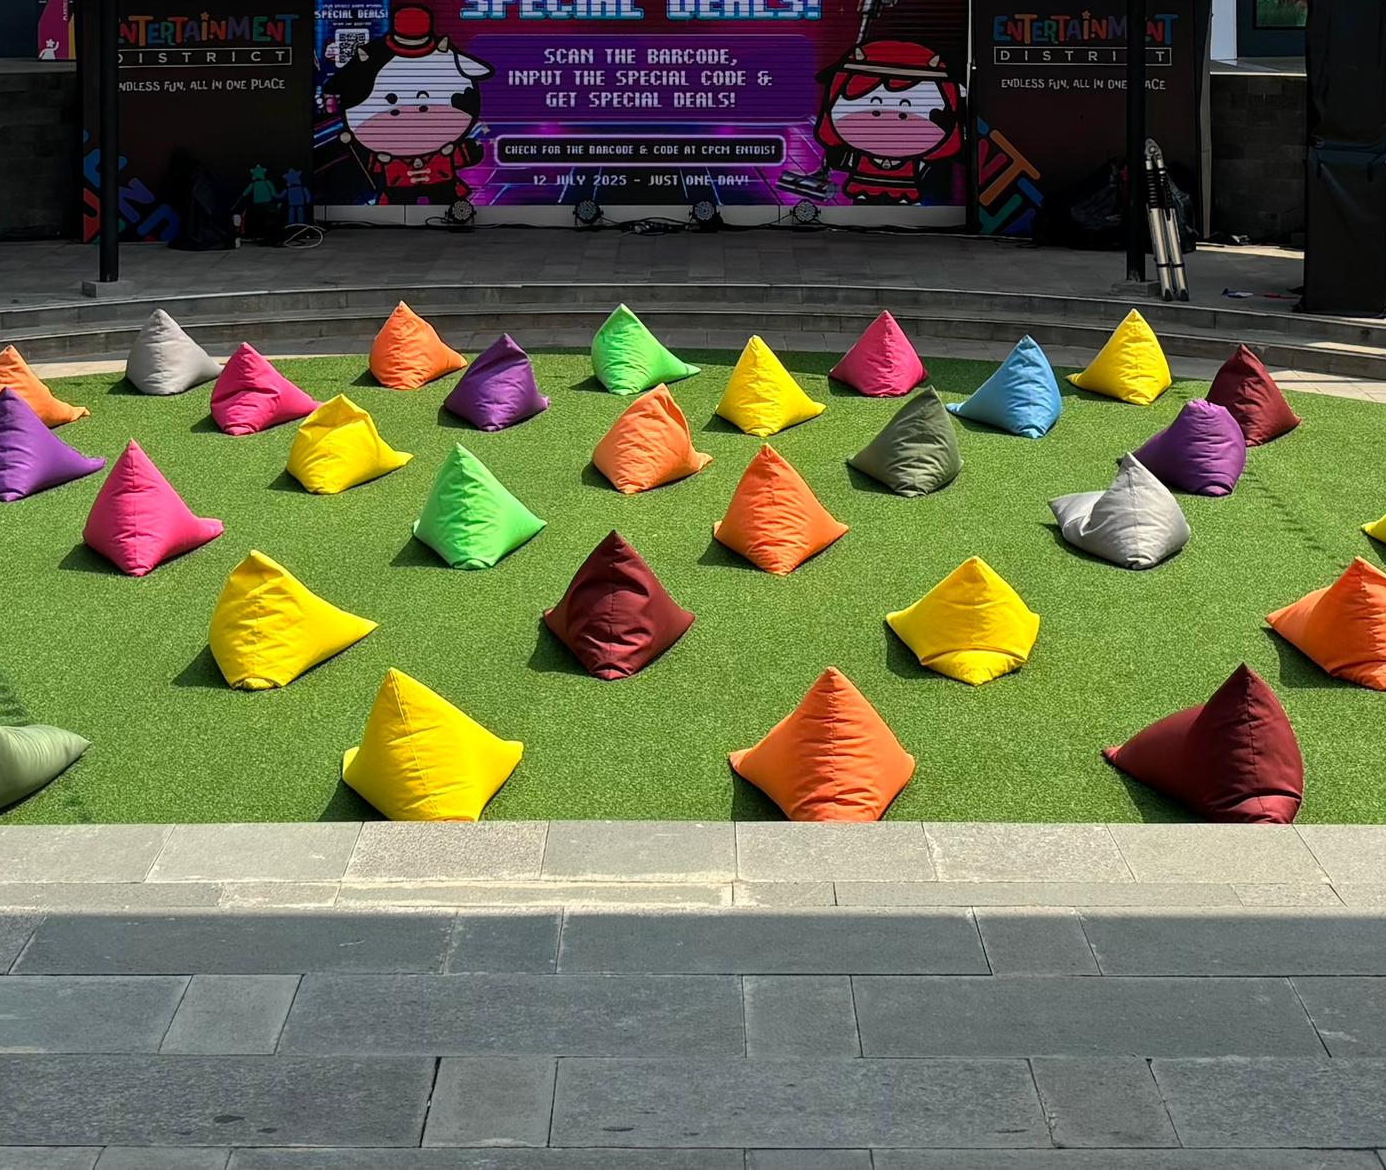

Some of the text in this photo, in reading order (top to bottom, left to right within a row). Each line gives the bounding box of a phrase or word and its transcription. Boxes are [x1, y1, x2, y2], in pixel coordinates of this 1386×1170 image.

[118, 11, 300, 46] NTERTAINMENT
[993, 10, 1179, 45] ENTERTAINMNT
[544, 48, 738, 66] SCAN THE BARCODE,
[1000, 50, 1165, 61] DISTRIT
[118, 81, 160, 92] NDLESS
[190, 79, 208, 90] ALL
[226, 79, 247, 90] ONE
[251, 78, 285, 89] PLACE
[508, 70, 773, 86] INPUT THE SPECIAL CODE &
[1001, 78, 1045, 88] ENDLESS
[1073, 78, 1090, 88] ALL
[1108, 78, 1127, 89] ONE
[545, 92, 736, 108] GET SPECIAL DEALS!
[505, 145, 537, 154] CHECK
[542, 145, 561, 154] FOR
[566, 145, 584, 154] THE
[589, 145, 634, 154] BARCODE
[639, 145, 648, 155] &
[653, 145, 679, 154] CODE
[684, 145, 696, 154] AT
[533, 175, 547, 186] 12
[556, 175, 586, 186] JULY
[593, 175, 627, 186] 2025
[648, 175, 678, 186] JUST
[686, 175, 711, 186] ONE
[718, 175, 749, 186] DAY!
